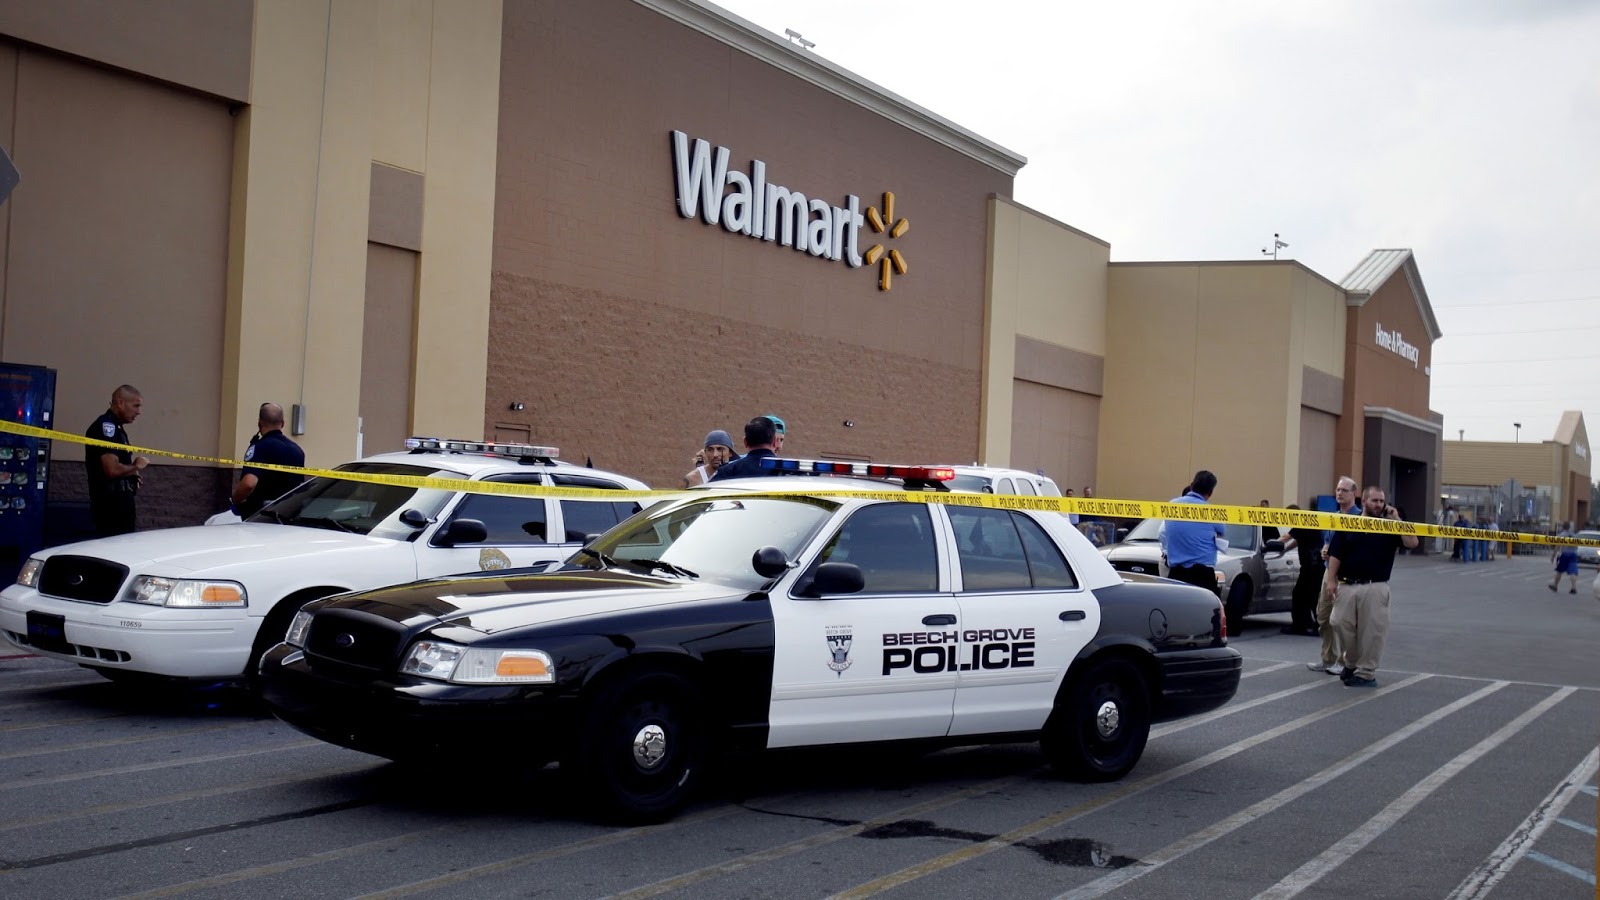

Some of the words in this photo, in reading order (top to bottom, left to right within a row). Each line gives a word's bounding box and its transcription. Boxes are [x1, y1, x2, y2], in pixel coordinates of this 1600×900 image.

[670, 130, 864, 268] Walmart
[1375, 322, 1391, 351] Home
[1396, 332, 1419, 369] Pharmacy
[999, 497, 1016, 508] POLICE
[1016, 498, 1027, 509] LINE
[1027, 499, 1034, 510] DO
[1034, 499, 1044, 510] NOT
[1044, 499, 1060, 511] CROSS
[1078, 501, 1095, 513] POLICE
[1095, 502, 1107, 514] LINE
[1107, 502, 1114, 515] DO
[1114, 502, 1125, 515] NOT
[1125, 503, 1142, 516] CROSS
[1160, 505, 1179, 518] POLICE
[1179, 506, 1191, 519] LINE
[1191, 507, 1199, 519] DO
[1199, 507, 1209, 520] NOT
[1210, 508, 1228, 521] CROSS
[1248, 510, 1267, 523] POLICE
[1267, 511, 1280, 524] LINE
[1280, 512, 1288, 525] DO
[1288, 513, 1300, 525] NOT
[1300, 513, 1319, 526] CROSS
[1340, 516, 1360, 529] POLICE
[1360, 518, 1374, 530] LINE
[1374, 519, 1383, 531] DO
[1383, 520, 1395, 532] NOT
[1395, 521, 1416, 533] CROSS
[1438, 526, 1460, 536] POLICE
[1460, 527, 1475, 537] LINE
[1475, 528, 1484, 538] DO
[1485, 529, 1497, 539] NOT
[1498, 530, 1519, 541] CROSS
[120, 620, 142, 628] 110659
[882, 631, 958, 646] BEECH
[963, 628, 1035, 643] GROVE
[882, 642, 1035, 675] POLICE
